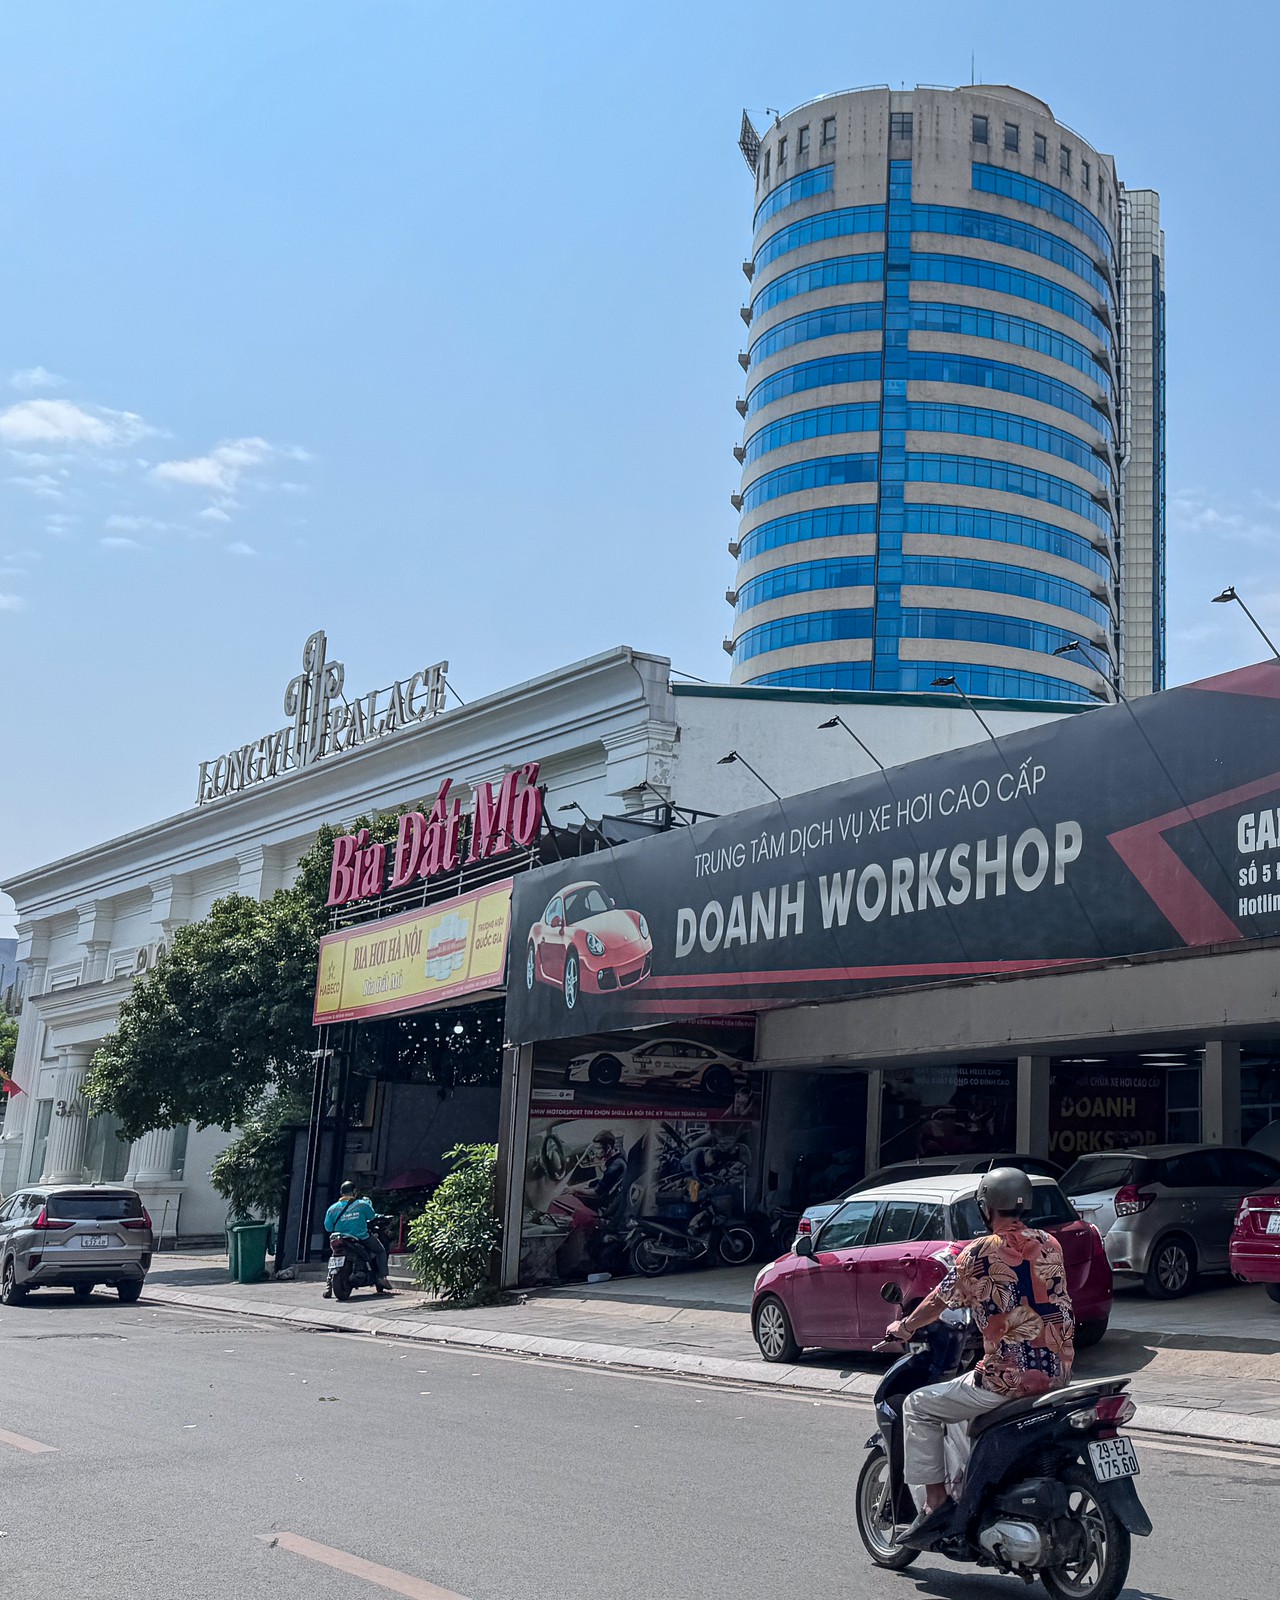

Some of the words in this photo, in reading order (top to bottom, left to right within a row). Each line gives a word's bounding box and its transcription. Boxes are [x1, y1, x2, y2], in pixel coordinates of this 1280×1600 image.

[328, 660, 449, 754] PALACE
[694, 843, 746, 878] TRUNG
[750, 831, 785, 864] TÂM
[790, 819, 833, 857] DỊCH
[838, 811, 863, 844] VỤ
[868, 804, 891, 835] XE
[897, 793, 933, 828] HƠI
[938, 779, 990, 816] CAO
[996, 756, 1046, 802] CẤP
[325, 828, 387, 907] Bia
[389, 778, 462, 890] Đất
[465, 762, 543, 864] Mỏ
[1238, 859, 1258, 887] SỐ
[1262, 864, 1272, 883] 5
[675, 880, 806, 959] DOANH
[818, 820, 1083, 930] WORKSHOP
[353, 946, 367, 971] BIA
[369, 939, 387, 967] HƠI
[387, 929, 401, 963] HÀ
[402, 924, 424, 964] NỘI
[319, 981, 341, 997] HABECO
[55, 1098, 83, 1118] 3A
[1060, 1096, 1136, 1118] DOANH
[1096, 1438, 1129, 1461] 29-E2
[1098, 1456, 1137, 1479] 175.60
